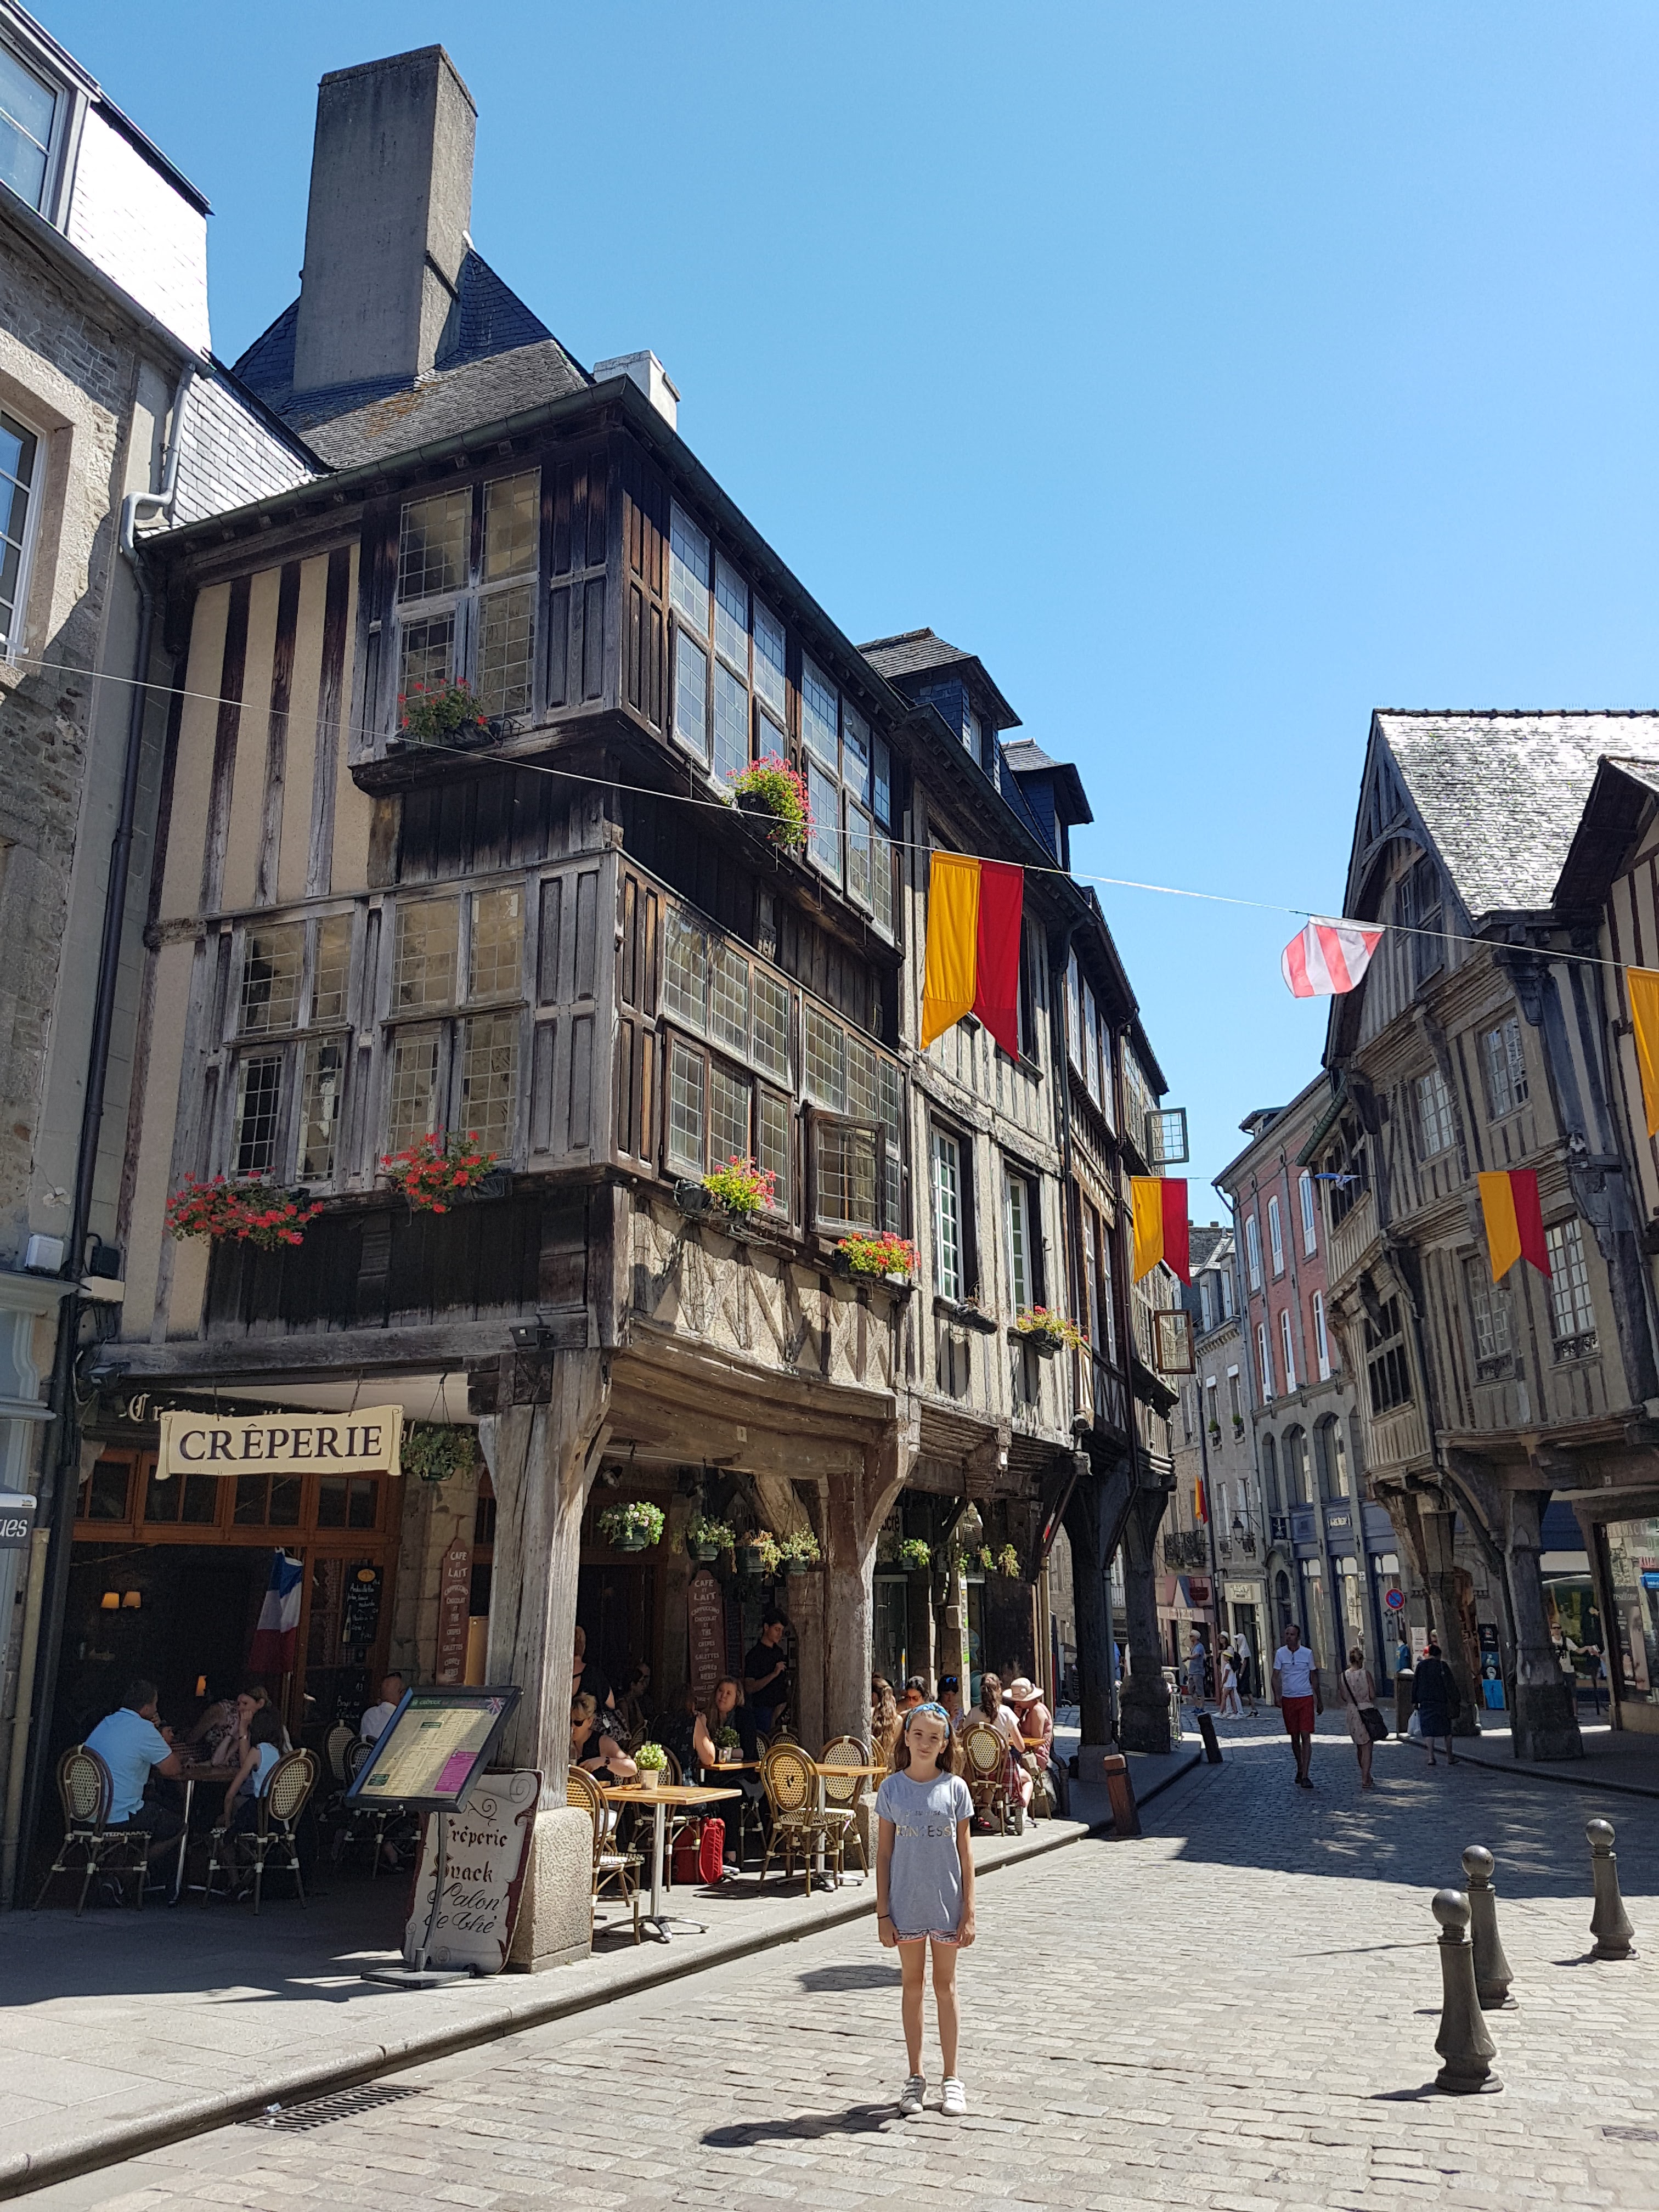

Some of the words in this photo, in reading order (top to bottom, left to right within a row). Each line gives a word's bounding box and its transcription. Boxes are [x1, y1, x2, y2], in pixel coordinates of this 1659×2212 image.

[179, 1423, 382, 1460] CRÊPERIE
[448, 1567, 468, 1577] LAIT
[693, 1592, 716, 1601] LAIT
